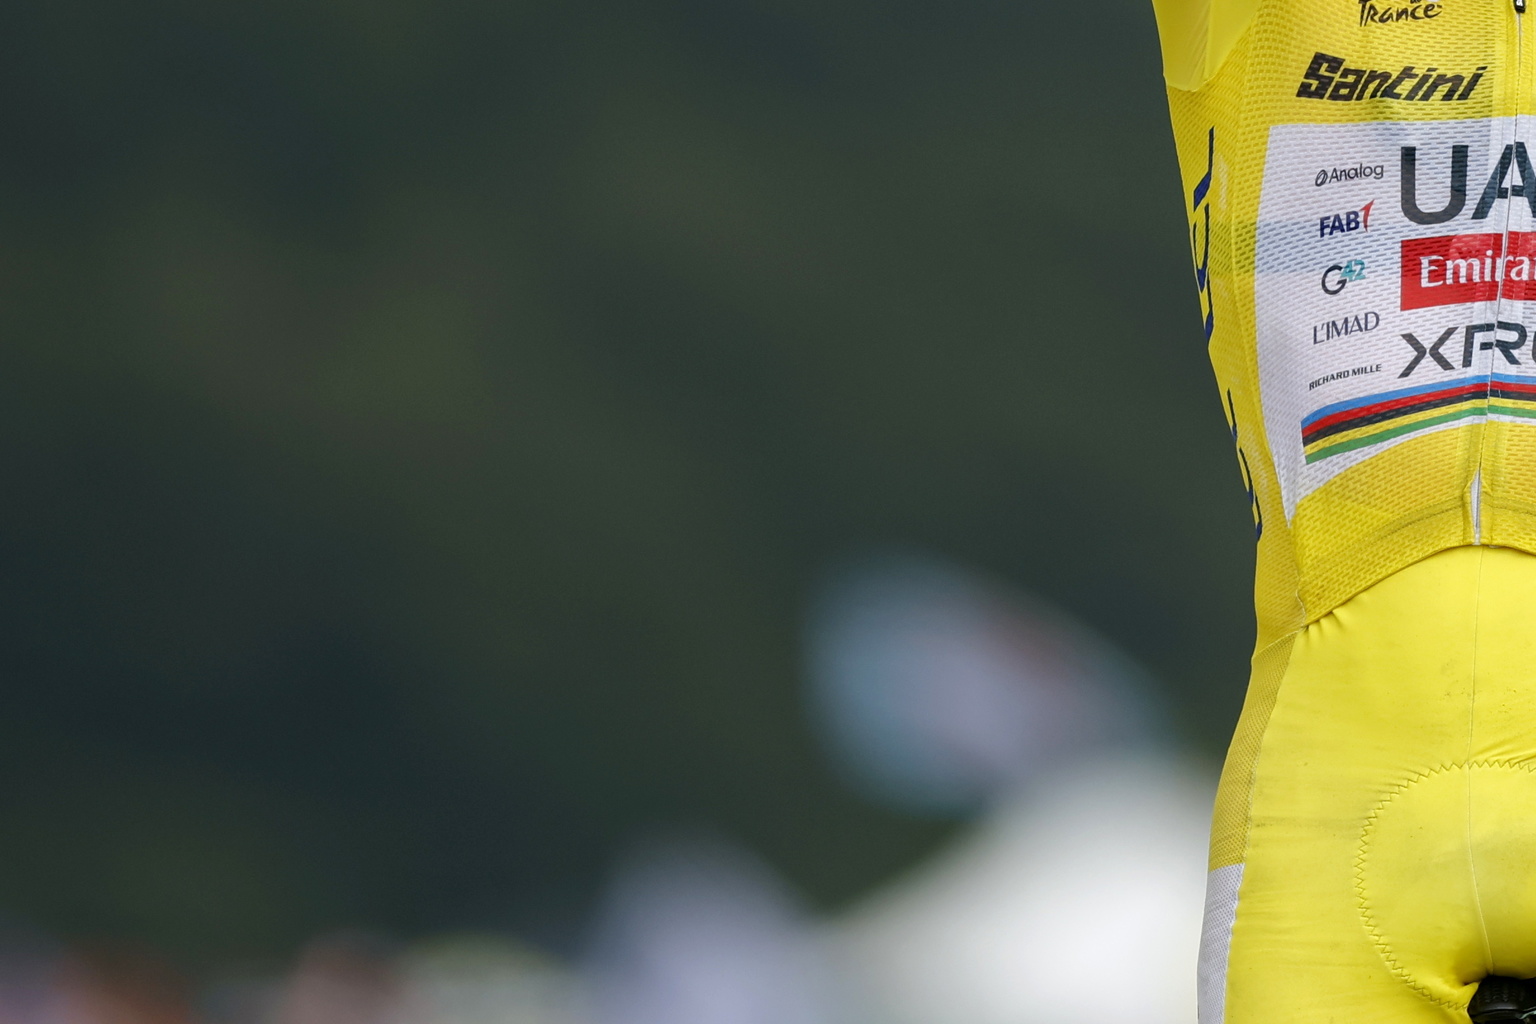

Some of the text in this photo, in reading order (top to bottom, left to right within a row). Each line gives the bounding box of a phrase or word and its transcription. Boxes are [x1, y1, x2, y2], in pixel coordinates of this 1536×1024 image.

[1296, 51, 1489, 102] Santini
[1328, 162, 1384, 184] Analog
[1321, 259, 1367, 295] G42
[1312, 311, 1380, 345] L'IMAD
[1308, 363, 1383, 392] RICHARD MILLE
